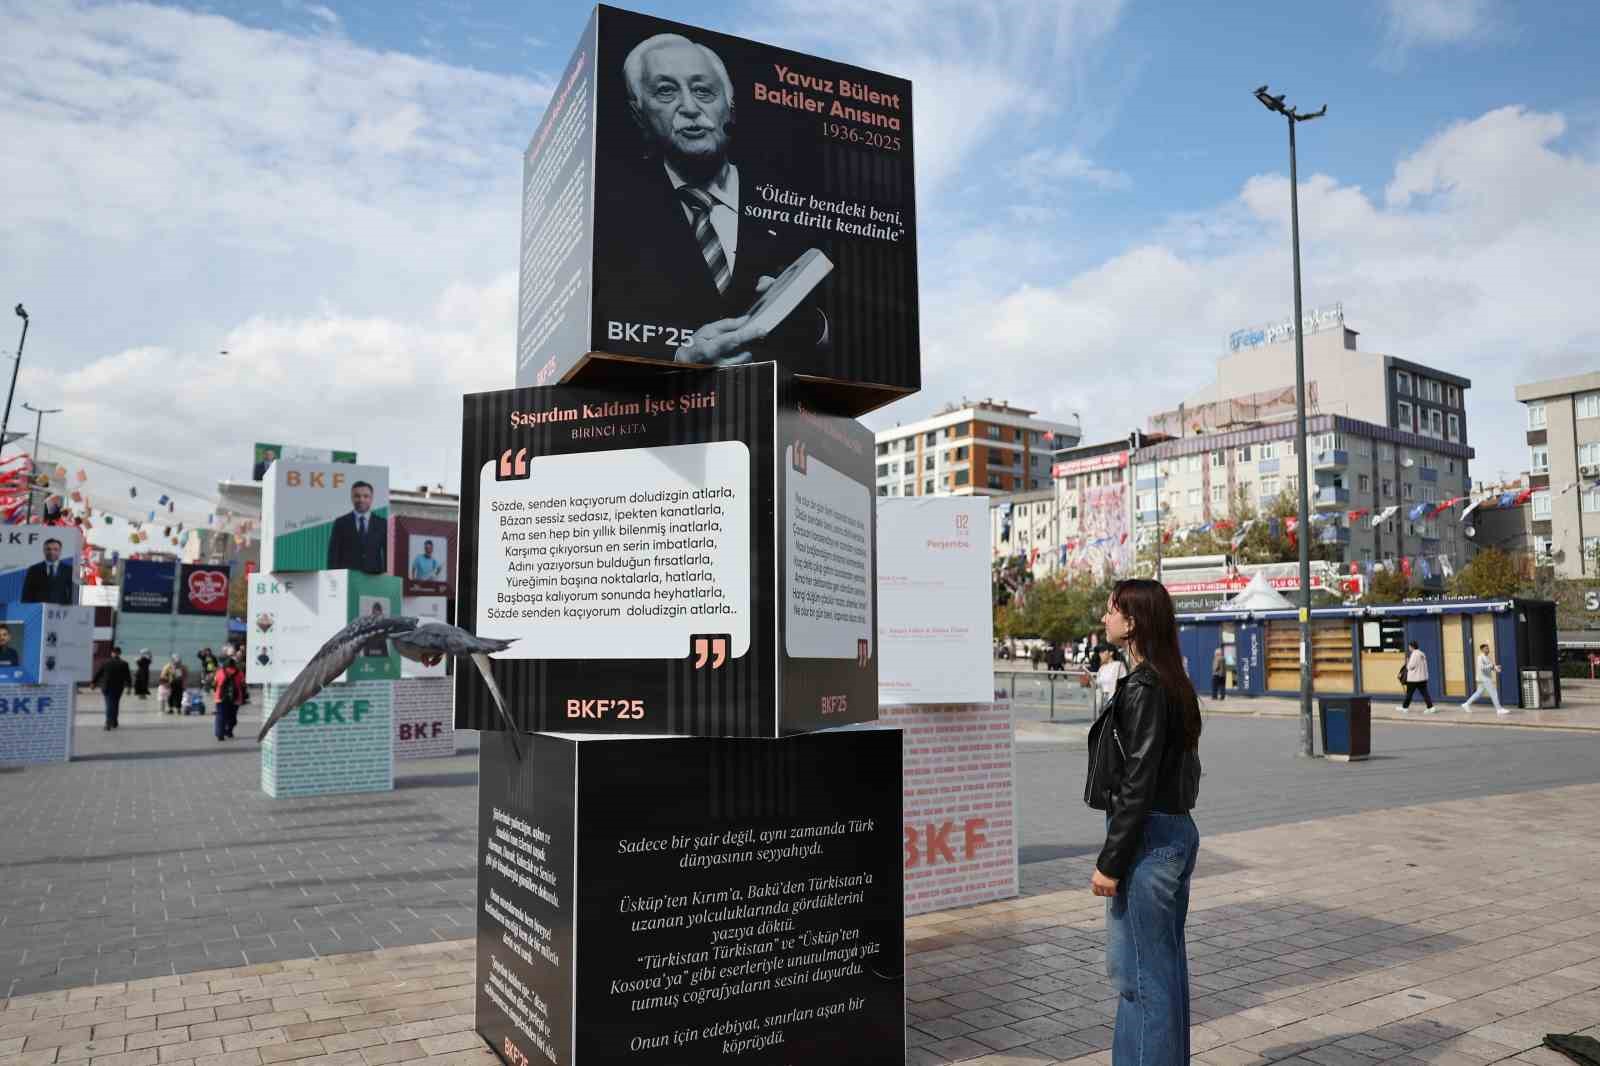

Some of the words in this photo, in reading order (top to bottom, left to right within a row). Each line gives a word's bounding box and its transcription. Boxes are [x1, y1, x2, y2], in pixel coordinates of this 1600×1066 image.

[774, 64, 834, 94] Yavuz
[839, 79, 900, 110] Bülent
[754, 82, 825, 113] Bakiler
[829, 100, 900, 131] Anısına
[823, 122, 901, 151] 1936-2025
[744, 205, 790, 223] sonra
[794, 211, 832, 230] dirilt
[809, 194, 866, 218] bendeki
[870, 206, 902, 226] beni,
[608, 320, 694, 348] BKF’25
[510, 406, 578, 430] Şaşırdım
[582, 401, 639, 419] Kaldım
[680, 391, 716, 413] Şiiri
[286, 470, 346, 488] BKF
[491, 500, 525, 512] Sözde,
[528, 497, 567, 510] senden
[570, 496, 626, 509] kaçıyorum
[629, 490, 689, 504] doludizgin
[692, 486, 735, 500] atlarla,
[535, 512, 565, 524] sessiz
[568, 511, 612, 522] sedasız,
[614, 508, 658, 523] ipekten
[660, 503, 724, 517] kanatlarla,
[501, 531, 526, 542] Ama
[528, 531, 547, 540] sen
[549, 528, 570, 541] hep
[573, 527, 590, 538] bin
[592, 525, 616, 540] yıllık
[619, 523, 666, 536] bilenmiş
[669, 520, 722, 533] inatlarla,
[505, 546, 547, 558] Karşıma
[549, 544, 603, 558] çıkıyorsun
[606, 543, 620, 552] en
[623, 540, 650, 552] serin
[653, 536, 717, 550] imbatlarla,
[508, 561, 534, 572] Adını
[537, 560, 594, 573] yazıyorsun
[596, 556, 651, 570] bulduğun
[654, 553, 713, 566] fırsatlarla,
[256, 581, 296, 594] BKF
[506, 576, 558, 590] Yüreğimin
[560, 575, 598, 588] başına
[600, 571, 662, 584] noktalarla,
[666, 569, 716, 582] hatlarla,
[497, 592, 543, 606] Başbaşa
[545, 591, 598, 604] kalıyorum
[601, 588, 651, 600] sonunda
[654, 586, 726, 601] heyhatlarla,
[487, 608, 519, 619] Sözde
[521, 607, 561, 618] senden
[563, 606, 621, 620] kaçıyorum
[626, 604, 687, 618] doludizgin
[300, 700, 370, 724] BKF
[568, 699, 644, 719] BKF’25
[400, 722, 442, 740] BKF
[618, 837, 668, 854] Sadece
[671, 835, 691, 849] bir
[694, 833, 720, 850] şair
[760, 829, 787, 844] aynı
[790, 821, 845, 839] zamanda
[848, 818, 874, 833] Türk
[679, 851, 753, 869] dünyasının
[756, 841, 823, 862] seyyahıydı.
[631, 916, 683, 932] uzanan
[685, 900, 789, 929] yolculuklarında
[792, 890, 864, 915] gördüklerini
[710, 926, 754, 945] yazıya
[782, 938, 795, 950] ve
[690, 966, 716, 986] gibi
[719, 956, 784, 978] eserleriyle
[787, 945, 858, 968] unutulmaya
[860, 942, 880, 959] yüz
[631, 994, 680, 1012] tutmuş
[683, 979, 770, 1004] coğrafyaların
[774, 970, 809, 988] sesini
[812, 962, 863, 983] duyurdu.
[630, 1035, 669, 1051] Onun
[674, 1028, 698, 1046] için
[702, 1018, 760, 1038] edebiyat,
[764, 1008, 813, 1027] sınırları
[816, 1002, 845, 1018] aşan
[848, 997, 864, 1011] bir
[722, 1030, 785, 1055] köprüydü.
